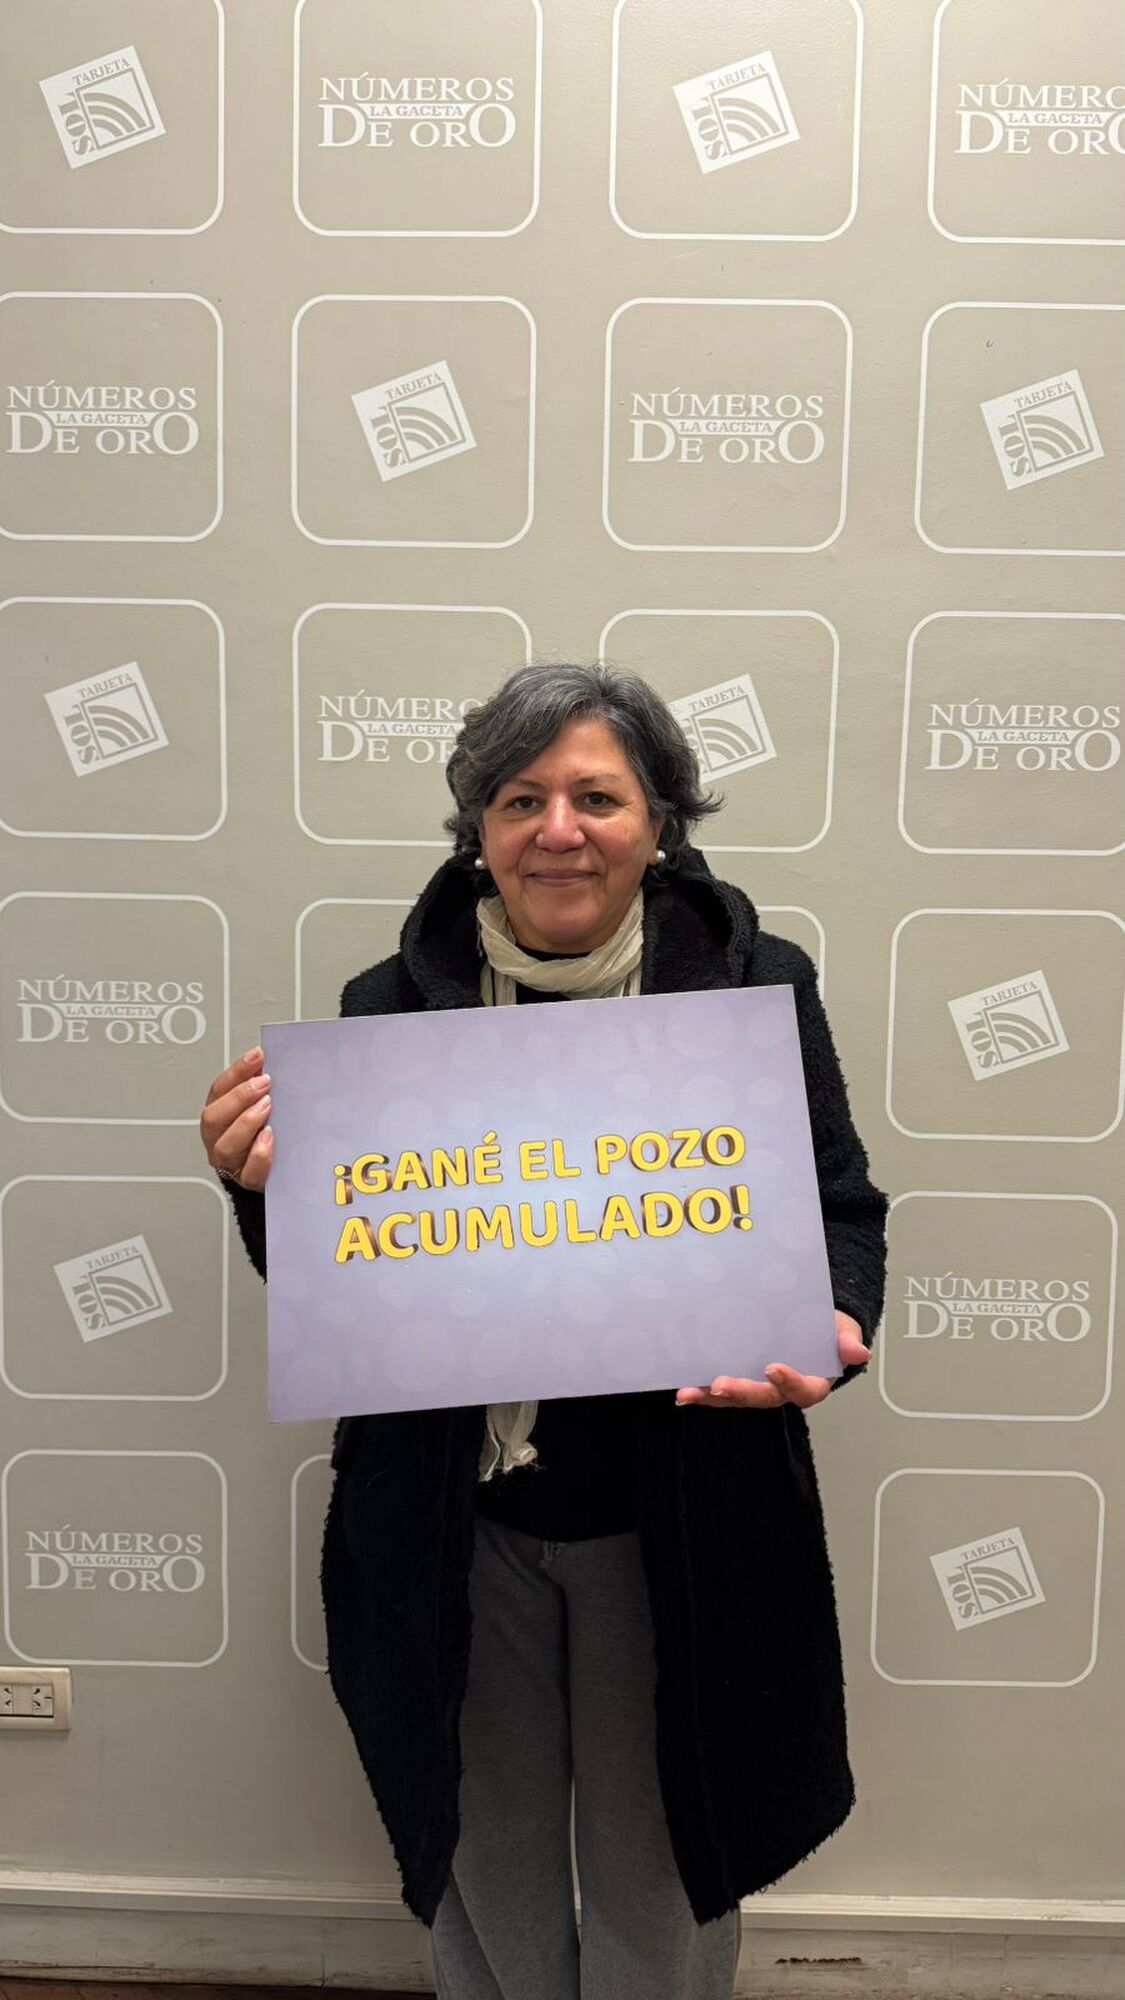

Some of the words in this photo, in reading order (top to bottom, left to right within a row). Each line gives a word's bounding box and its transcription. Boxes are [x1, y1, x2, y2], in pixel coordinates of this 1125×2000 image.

[72, 57, 130, 85] TARJETA
[707, 62, 766, 90] TARJETA
[320, 72, 514, 101] NÚMEROS
[958, 79, 1125, 109] NÚMERO
[59, 91, 95, 155] SOL
[318, 104, 393, 147] DE
[410, 103, 516, 148] ORO
[370, 106, 391, 116] LA
[396, 106, 463, 117] GACETA
[1008, 113, 1030, 123] LA
[1035, 114, 1103, 125] GACETA
[693, 96, 728, 160] SOL
[954, 110, 1031, 154] DE
[7, 381, 196, 410] NÚMEROS
[384, 372, 442, 399] TARJETA
[1014, 380, 1072, 407] TARJETA
[631, 388, 823, 418] NÚMEROS
[6, 411, 79, 453] DE
[96, 412, 199, 455] ORO
[56, 414, 77, 423] LA
[82, 414, 147, 425] GACETA
[680, 422, 701, 432] LA
[706, 422, 772, 433] GACETA
[371, 405, 406, 468] SOL
[628, 419, 703, 463] DE
[720, 420, 825, 465] ORO
[999, 413, 1033, 476] SOL
[76, 673, 133, 699] TARJETA
[688, 685, 744, 711] TARJETA
[929, 699, 1120, 728] NÚMEROS
[64, 705, 100, 764] SOL
[317, 720, 390, 762] DE
[367, 723, 388, 733] LA
[392, 724, 457, 735] GACETA
[978, 731, 998, 741] LA
[1003, 732, 1069, 742] GACETA
[925, 729, 999, 770] DE
[1016, 730, 1121, 772] ORO
[18, 975, 204, 1003] NÚMEROS
[980, 980, 1038, 1005] TARJETA
[17, 1003, 89, 1043] DE
[105, 1005, 207, 1045] ORO
[66, 1006, 87, 1015] LA
[966, 1011, 999, 1068] SOL
[334, 1131, 502, 1206] ¡GANÉ
[519, 1138, 581, 1181] EL
[595, 1125, 746, 1174] POZO
[333, 1184, 754, 1263] ACUMULADO!
[85, 1245, 139, 1269] TARJETA
[905, 1272, 1090, 1302] NÚMEROS
[72, 1274, 106, 1330] SOL
[953, 1303, 973, 1312] LA
[977, 1304, 1041, 1314] GACETA
[903, 1300, 974, 1339] DE
[990, 1303, 1091, 1343] ORO
[27, 1527, 203, 1554] NÚMEROS
[961, 1537, 1015, 1560] TARJETA
[25, 1553, 94, 1590] DE
[109, 1555, 205, 1593] ORO
[73, 1556, 92, 1564] LA
[947, 1565, 979, 1619] SOL
